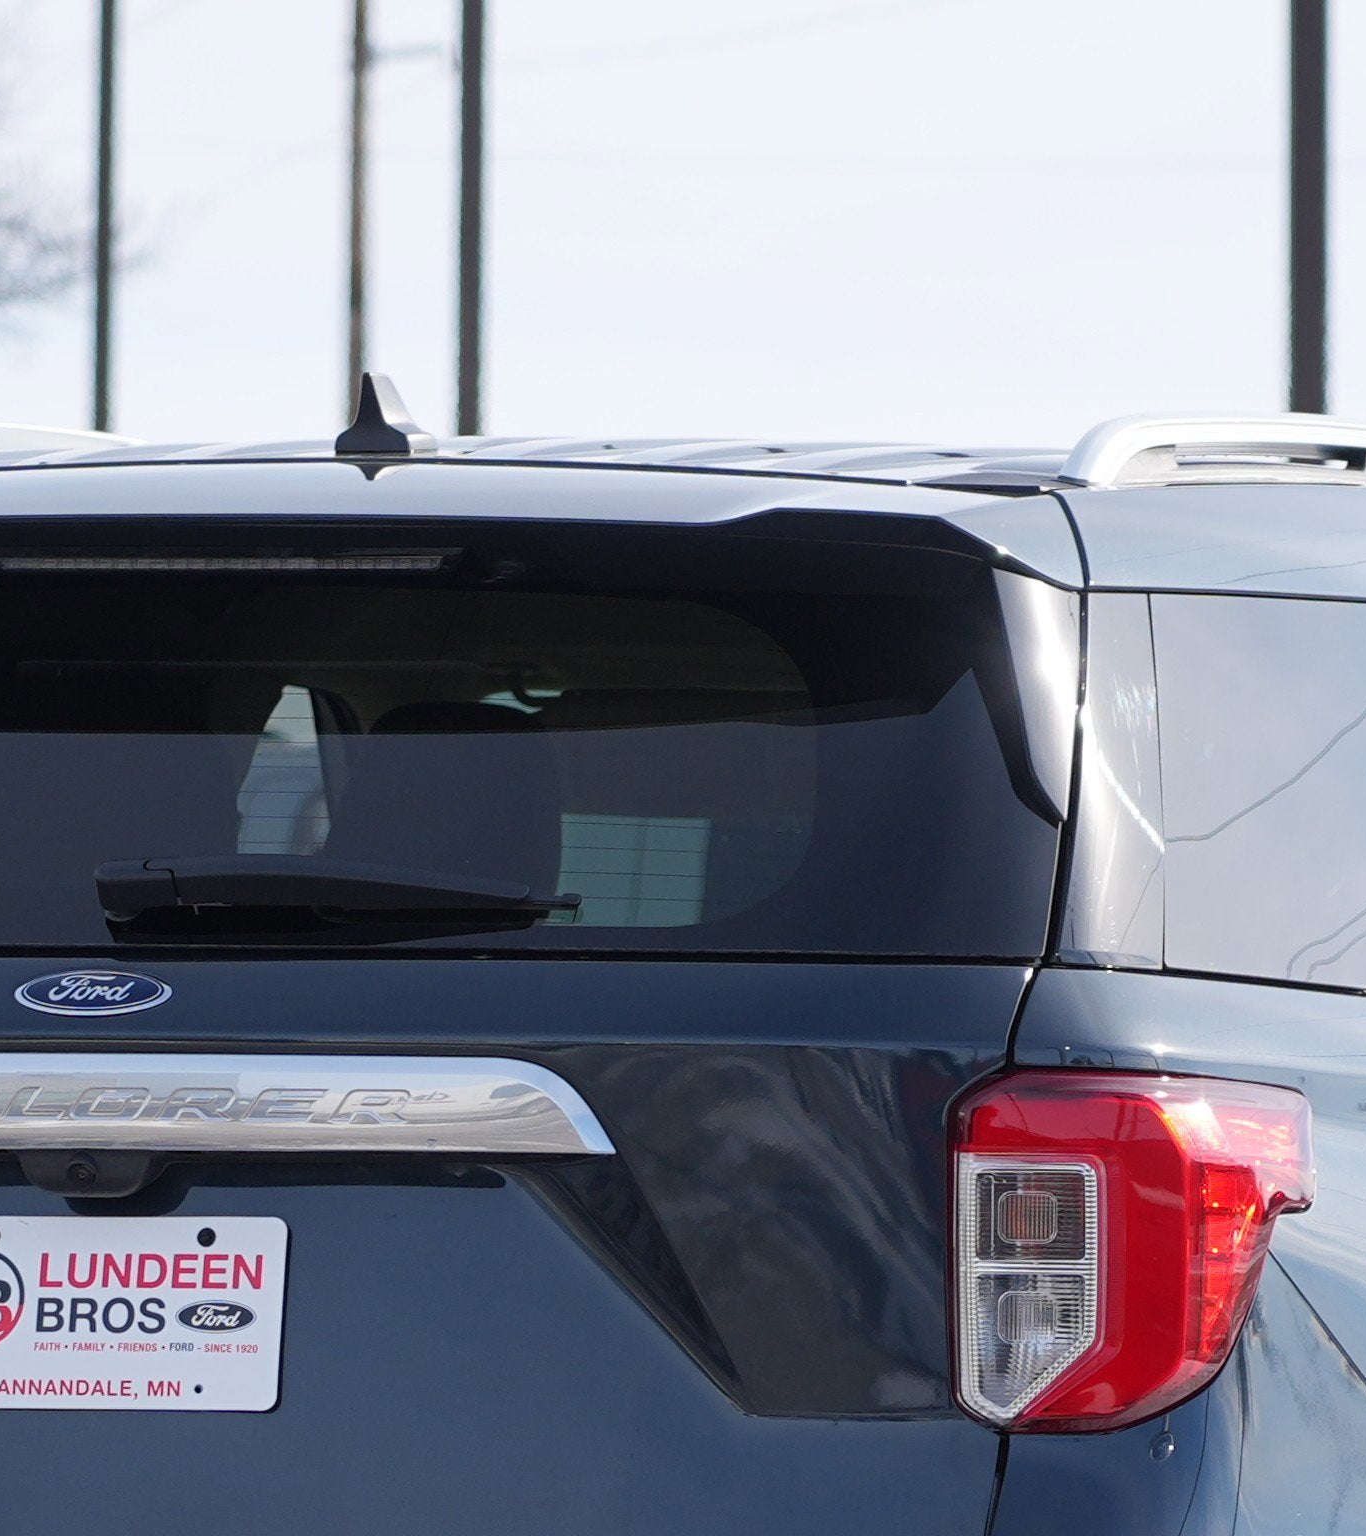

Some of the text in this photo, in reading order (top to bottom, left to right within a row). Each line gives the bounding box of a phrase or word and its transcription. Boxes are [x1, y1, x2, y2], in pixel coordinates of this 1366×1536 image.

[48, 974, 135, 1001] Ford
[38, 1252, 264, 1290] LUNDEEN
[35, 1297, 166, 1334] BROS
[190, 1303, 241, 1328] Ford
[34, 1341, 259, 1354] FAITH FAMILY FRIENDS FORD SINCE 1920
[146, 1380, 181, 1397] MN
